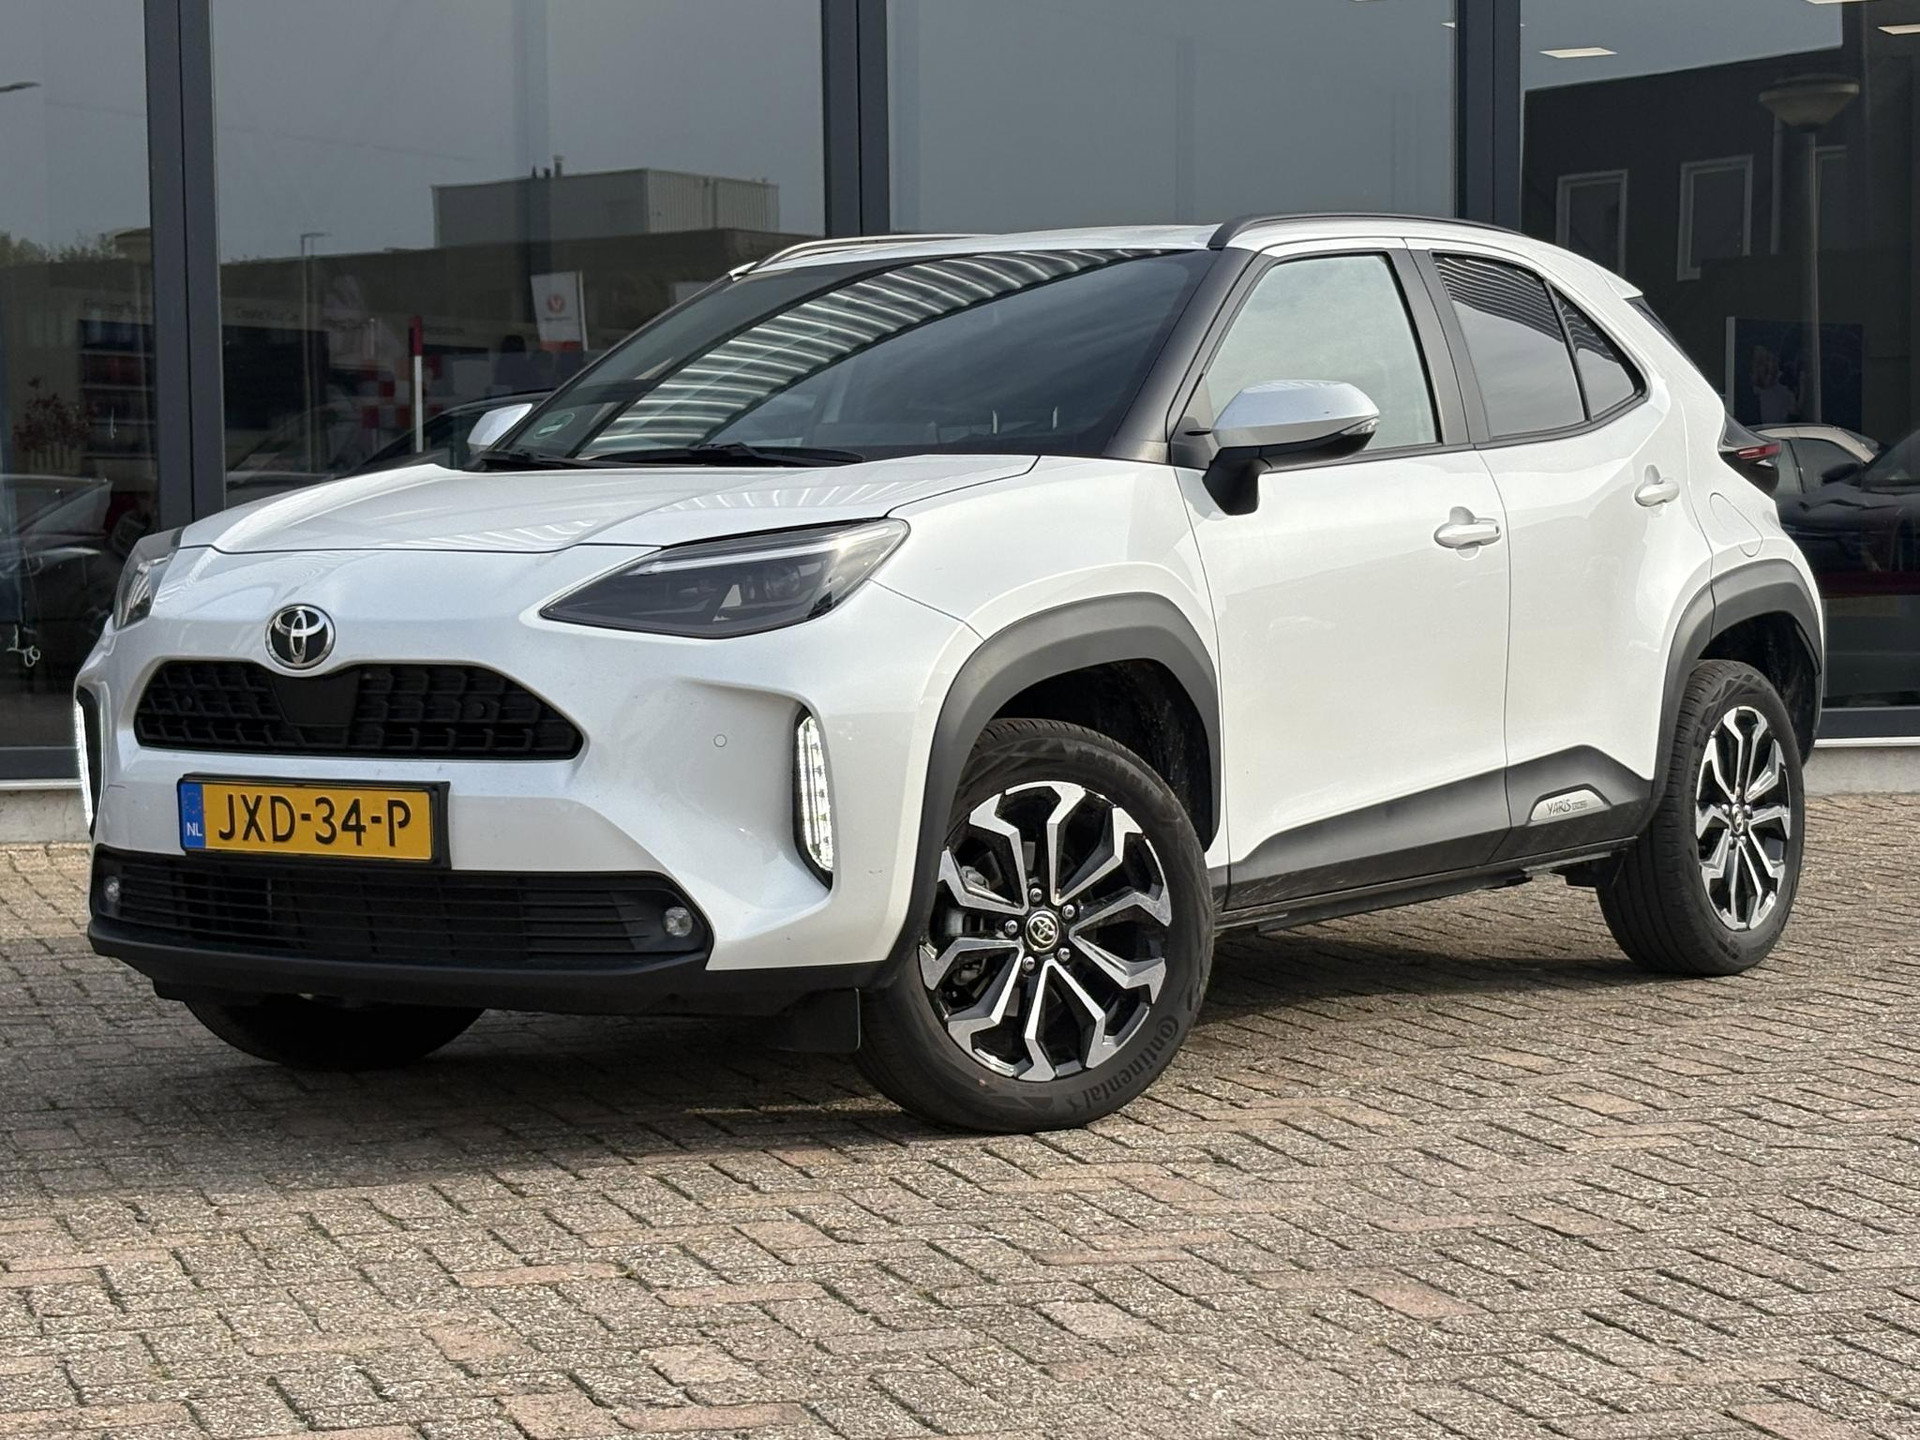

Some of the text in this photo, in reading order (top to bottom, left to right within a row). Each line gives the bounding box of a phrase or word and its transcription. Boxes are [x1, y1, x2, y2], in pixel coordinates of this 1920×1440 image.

[187, 822, 203, 836] NL
[218, 793, 412, 847] JXD-34-P
[1082, 1014, 1180, 1109] Continental
